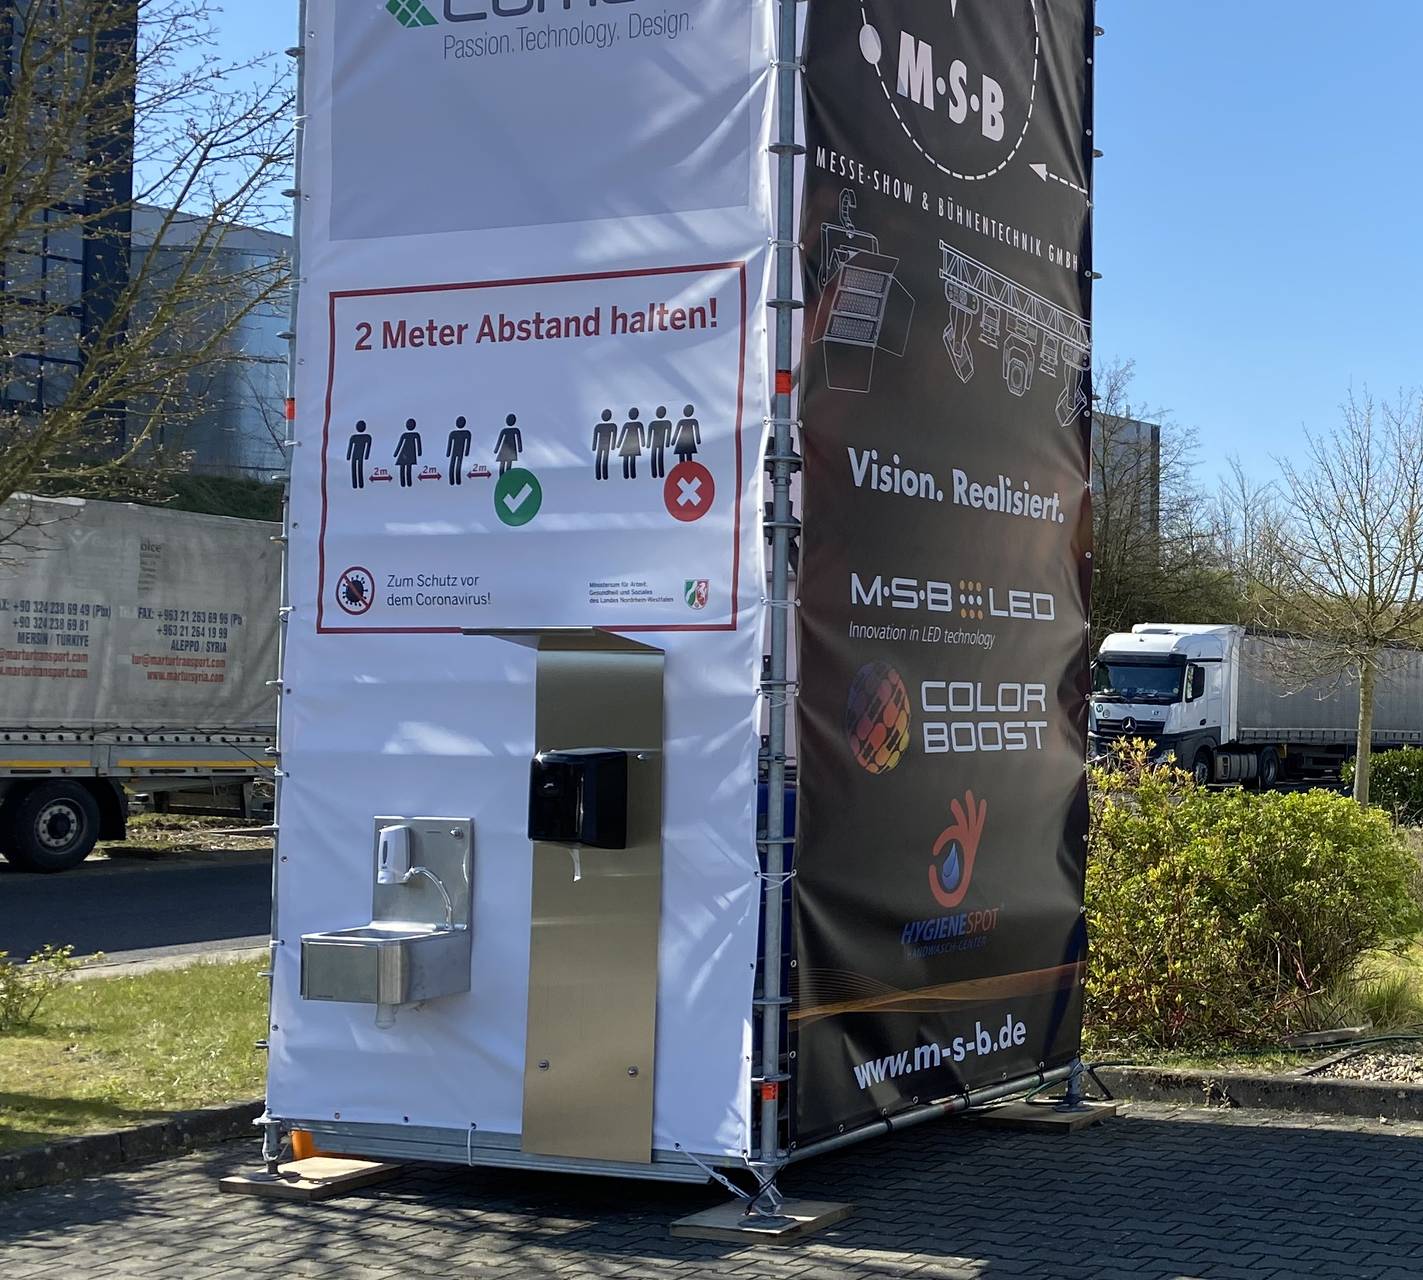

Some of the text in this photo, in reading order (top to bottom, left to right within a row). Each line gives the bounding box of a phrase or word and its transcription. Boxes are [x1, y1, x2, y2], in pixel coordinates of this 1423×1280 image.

[444, 10, 695, 60] Passion. Technology. Design.
[922, 191, 929, 211] &
[938, 196, 1041, 257] BÜHNENTECHNIK
[1048, 244, 1078, 272] GMBH
[355, 297, 719, 350] 2 Meter Abstand halten!
[374, 467, 387, 475] 2m
[423, 465, 437, 474] 2m
[473, 463, 487, 472] 2m
[847, 447, 1064, 523] Vision. Realisiert.
[387, 574, 479, 588] Zum Schutz vor
[33, 601, 48, 614] 324
[386, 592, 491, 606] dem Coronavirus!
[989, 587, 1055, 621] LED
[33, 617, 48, 630] 324
[180, 610, 189, 622] 21
[180, 626, 188, 637] 21
[208, 627, 216, 639] 19
[849, 620, 996, 649] Innovation in LED technology
[170, 640, 200, 652] ALEPPO
[206, 641, 227, 653] SYRIA
[921, 681, 1046, 712] COLOR
[923, 721, 1048, 753] BOOST
[901, 907, 1000, 944] HYGIENESPOT
[853, 1014, 1027, 1090] www.m-s-b.de
